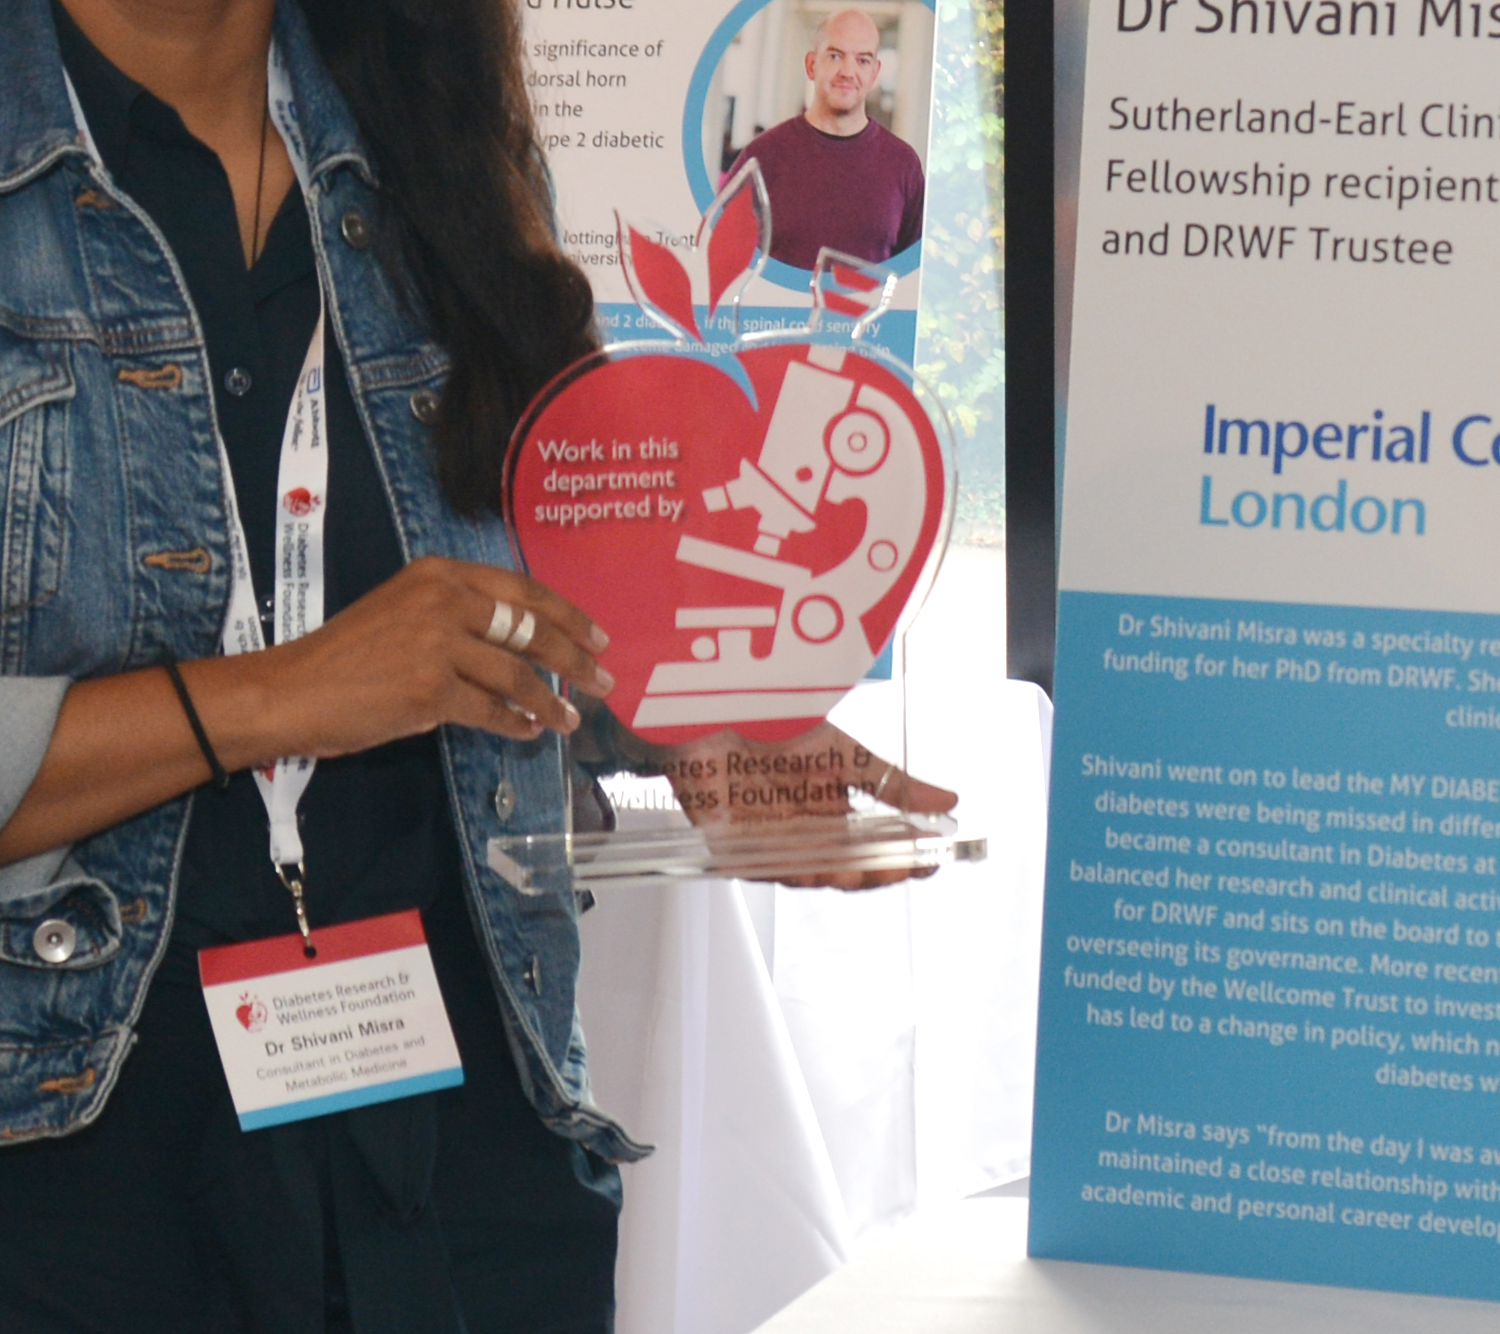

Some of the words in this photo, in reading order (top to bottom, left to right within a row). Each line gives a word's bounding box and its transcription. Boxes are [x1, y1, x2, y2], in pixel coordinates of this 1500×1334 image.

[533, 39, 639, 62] significance
[644, 39, 664, 57] of
[526, 67, 581, 89] dorsal
[585, 70, 626, 87] horn
[530, 98, 549, 121] in
[554, 100, 583, 117] the
[1108, 96, 1406, 136] Sutherland-Earl
[576, 131, 586, 147] 2
[592, 131, 663, 148] diabetic
[1106, 159, 1310, 207] Fellowship
[1325, 165, 1499, 210] recipient
[1102, 222, 1169, 256] and
[1184, 223, 1296, 259] DRWF
[1308, 227, 1453, 265] Trustee
[537, 438, 604, 461] Work
[611, 439, 631, 460] in
[639, 435, 678, 459] this
[1203, 404, 1431, 474] Imperial
[543, 469, 675, 495] department
[535, 496, 651, 526] supported
[657, 495, 684, 522] by
[1200, 475, 1426, 536] London
[273, 991, 333, 1010] Diabetes
[335, 977, 397, 997] Research
[398, 973, 410, 985] &
[275, 1006, 339, 1025] Wellness
[341, 991, 415, 1012] Foundation
[265, 1042, 285, 1056] Dr
[291, 1027, 353, 1050] Shivani
[358, 1019, 405, 1037] Misra
